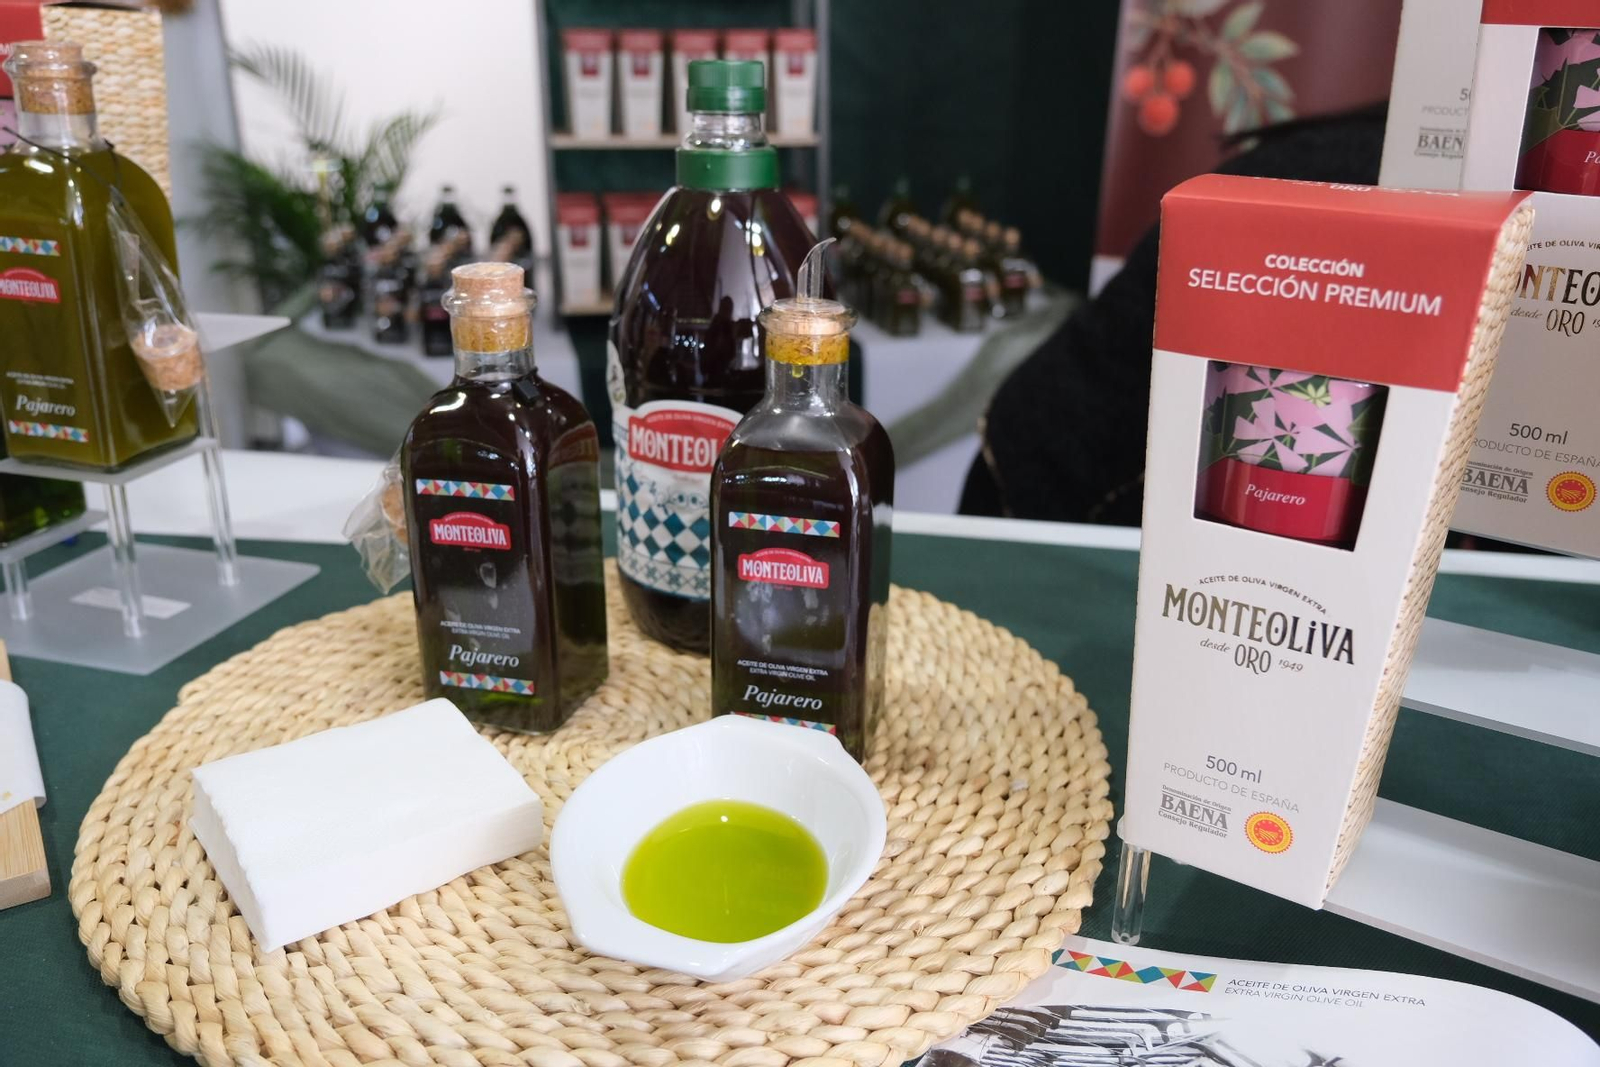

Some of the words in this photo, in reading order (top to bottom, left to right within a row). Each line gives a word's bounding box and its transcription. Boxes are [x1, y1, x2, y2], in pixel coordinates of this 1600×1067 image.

[1460, 88, 1470, 101] 5
[1265, 254, 1364, 277] COLECCIÓN
[1188, 268, 1318, 301] SELECCIÓN
[1324, 284, 1442, 316] PREMIUM
[1515, 264, 1600, 306] NTEO
[1511, 307, 1542, 318] desde
[1546, 308, 1585, 337] ORO
[16, 394, 76, 416] Pajarero
[1509, 423, 1542, 440] 500
[1546, 430, 1568, 445] ml
[1534, 448, 1552, 460] DE
[1462, 468, 1528, 494] BAENA
[1244, 484, 1306, 505] Pajarero
[1488, 490, 1527, 503] Regulador
[1199, 575, 1225, 584] ACEITE
[1242, 576, 1266, 586] OLIVA
[1270, 581, 1301, 598] VIRGEN
[1302, 595, 1326, 614] EXTRA
[449, 644, 520, 668] Pajarero
[1200, 638, 1231, 652] desde
[1234, 644, 1272, 674] ORO
[1278, 658, 1304, 673] 1949
[786, 666, 808, 674] VIRGEN
[809, 668, 828, 676] EXTRA
[743, 684, 822, 710] Pajarero
[1206, 755, 1237, 776] 500
[1240, 769, 1262, 784] ml
[1163, 762, 1228, 790] PRODUCTO
[1231, 784, 1248, 798] DE
[1251, 790, 1300, 814] ESPAÑA
[1163, 784, 1201, 802] Denominación
[1161, 793, 1228, 829] BAENA
[1158, 811, 1187, 825] Consejo
[1189, 821, 1228, 838] Regulador
[1224, 987, 1261, 998] EXTRA
[1264, 990, 1304, 1002] VIRGIN
[1306, 995, 1342, 1006] OLIVE
[1344, 998, 1364, 1008] OIL
[1228, 978, 1270, 990] ACEITE
[1273, 983, 1290, 992] DE
[1292, 984, 1328, 995] OLIVA
[1332, 988, 1379, 1000] VIRGEN
[1383, 994, 1426, 1007] EXTRA
